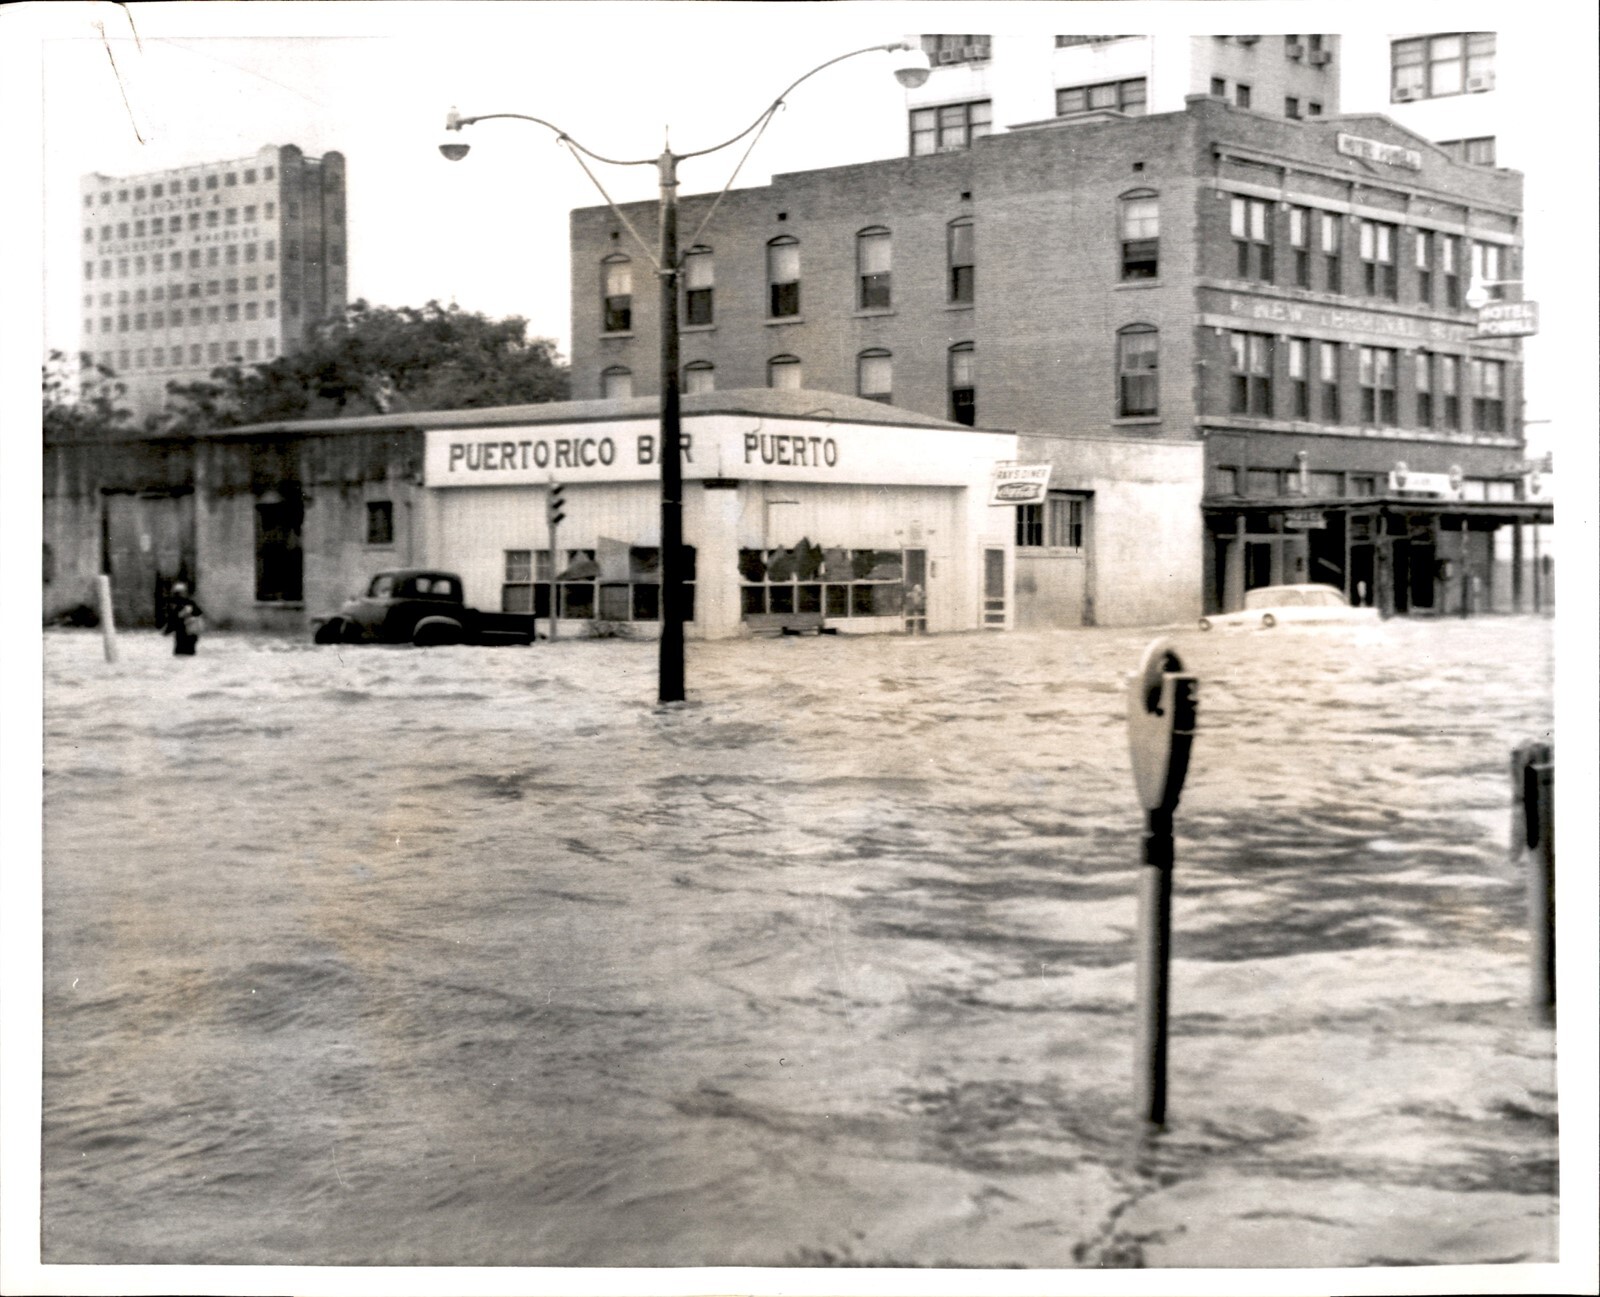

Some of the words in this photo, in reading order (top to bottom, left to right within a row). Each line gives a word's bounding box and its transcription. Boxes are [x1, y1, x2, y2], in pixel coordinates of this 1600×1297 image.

[1479, 304, 1533, 320] HOTEL
[449, 440, 550, 472] PUERTO
[555, 437, 616, 468] RICO
[637, 433, 693, 466] BR
[744, 433, 838, 468] PUERTO
